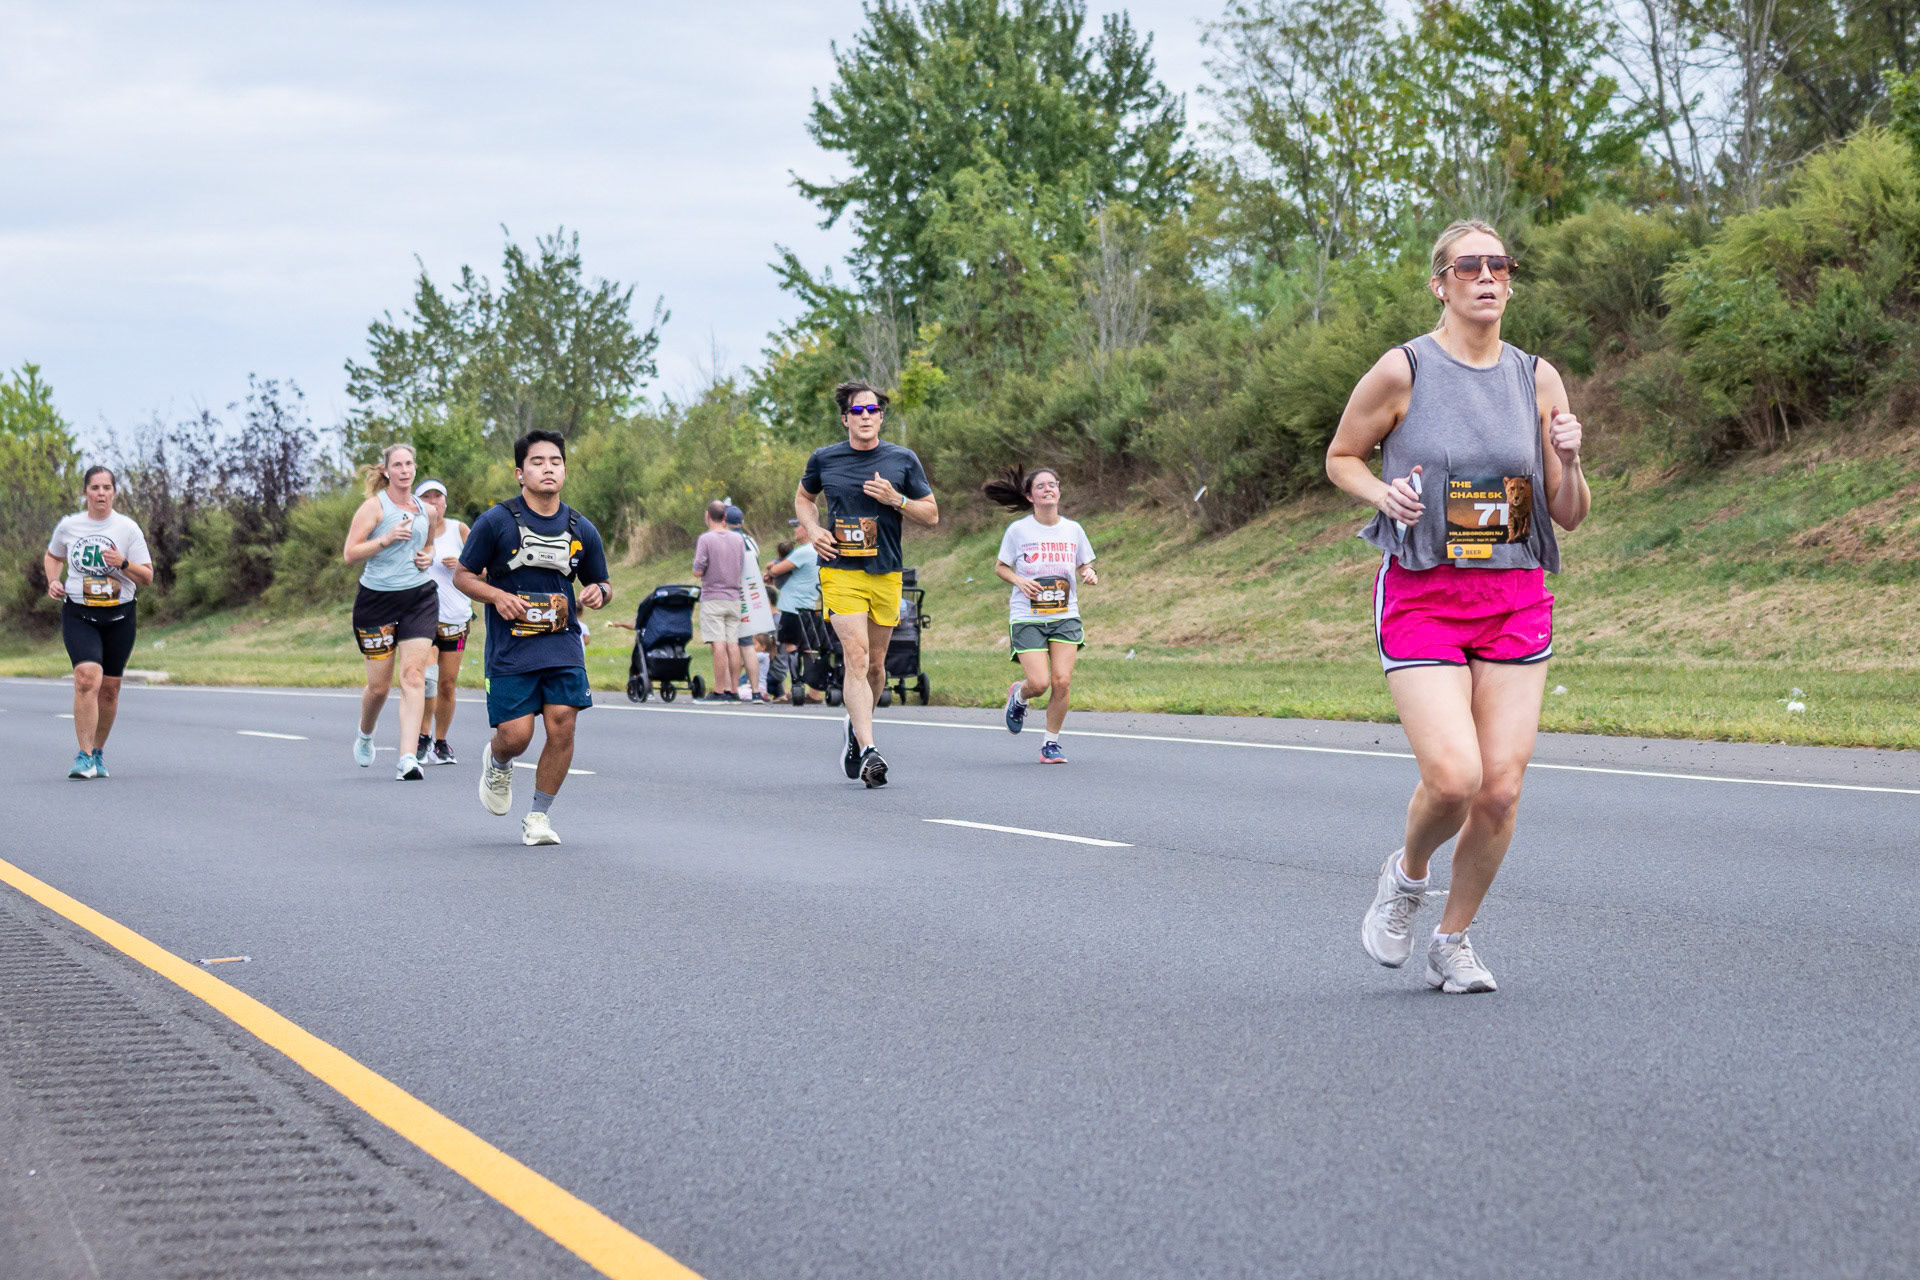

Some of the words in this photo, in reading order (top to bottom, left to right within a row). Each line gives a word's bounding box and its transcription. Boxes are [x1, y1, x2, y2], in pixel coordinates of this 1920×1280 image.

[1449, 480, 1472, 489] THE
[1449, 491, 1487, 499] CHASE
[1487, 491, 1503, 499] 5K
[1473, 503, 1510, 526] 71
[843, 530, 865, 541] 10
[1041, 542, 1068, 552] STRIDE
[1041, 553, 1074, 563] PROVI
[1037, 590, 1066, 602] 162
[526, 608, 558, 623] 64
[363, 634, 394, 649] 273
